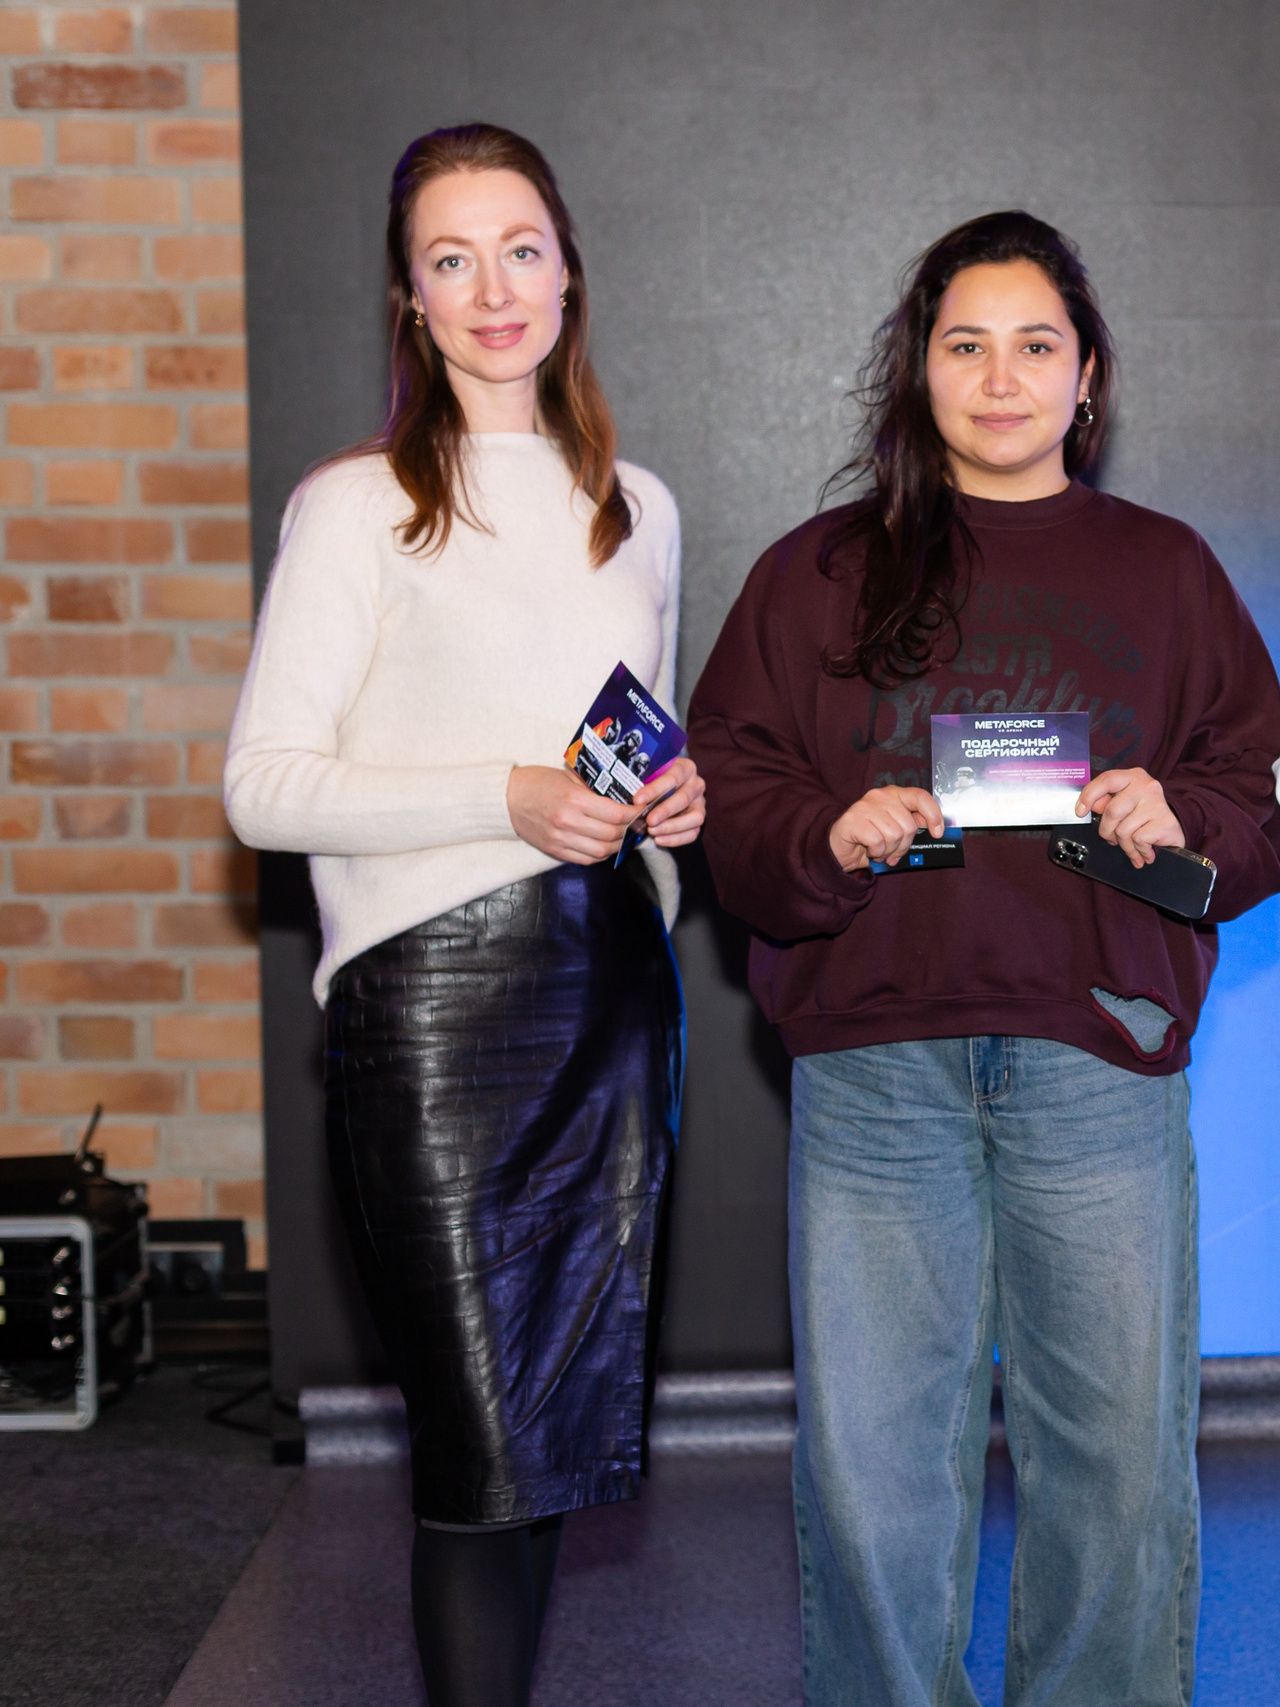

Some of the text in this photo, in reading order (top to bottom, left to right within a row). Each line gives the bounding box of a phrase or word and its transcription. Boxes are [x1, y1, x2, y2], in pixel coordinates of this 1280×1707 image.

[955, 582, 1145, 675] PIONSHIP
[626, 688, 666, 733] METAFORCE
[974, 719, 1045, 729] METAFORCE
[961, 735, 1060, 749] ПОДАРОЧНЫЙ
[965, 747, 1057, 758] СЕРТИФИКАТ
